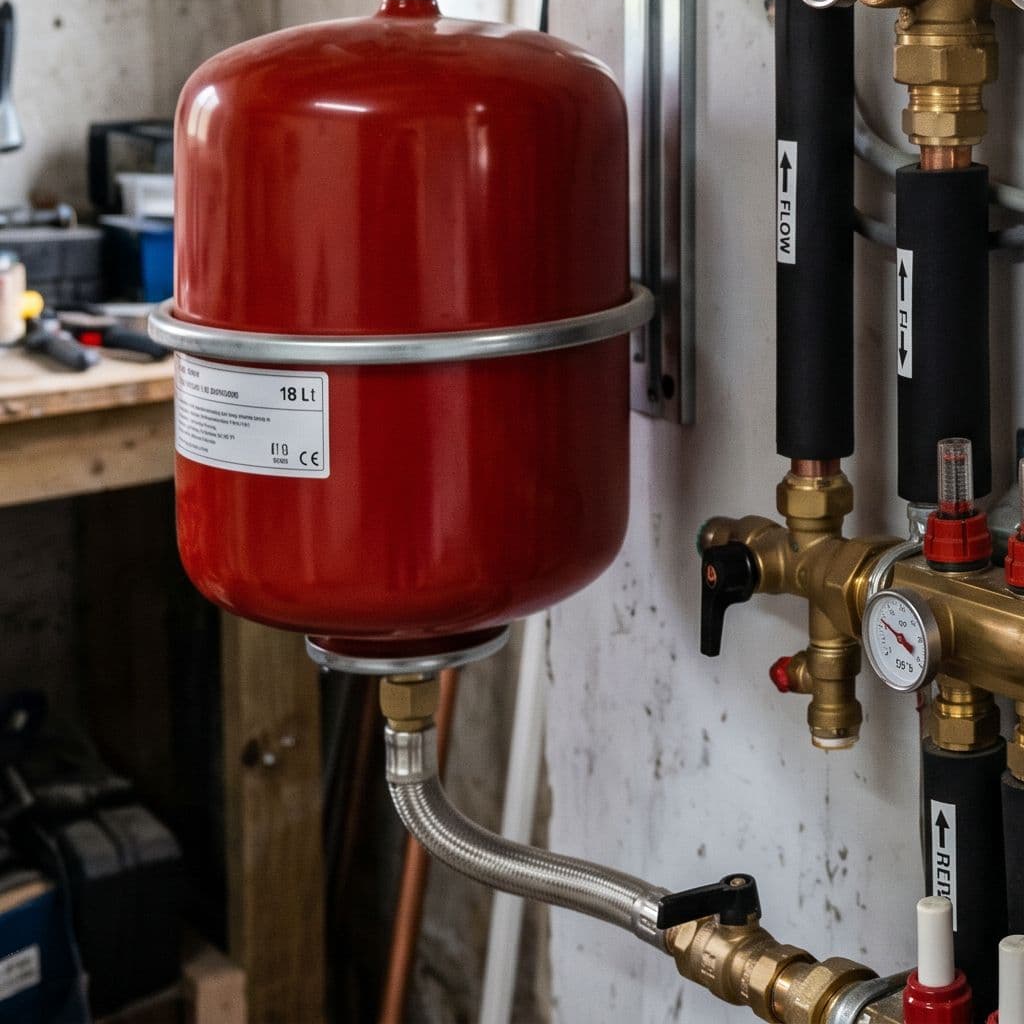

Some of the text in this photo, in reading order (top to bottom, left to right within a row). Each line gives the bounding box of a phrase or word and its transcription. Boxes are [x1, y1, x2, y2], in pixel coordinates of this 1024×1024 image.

[779, 199, 791, 254] FLOW
[280, 387, 316, 402] 18 Lt
